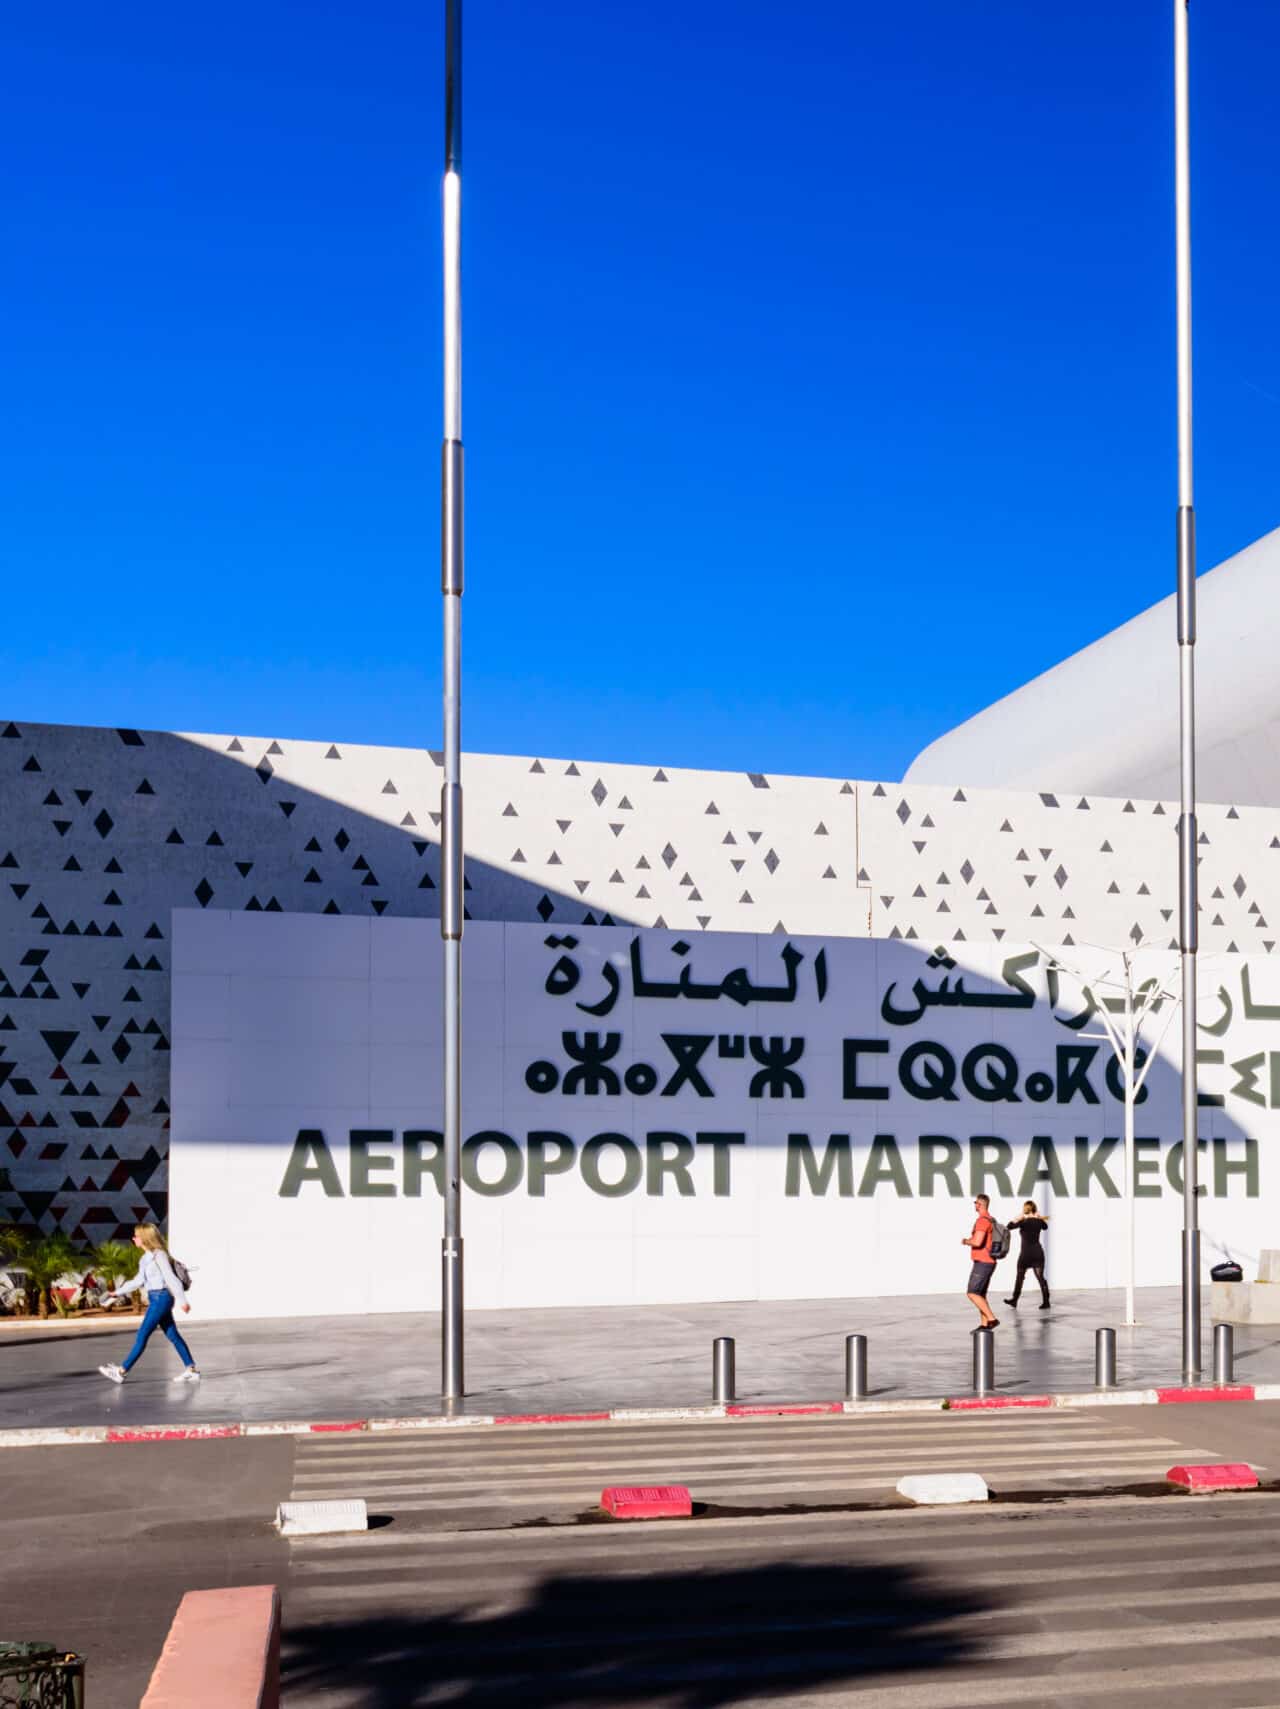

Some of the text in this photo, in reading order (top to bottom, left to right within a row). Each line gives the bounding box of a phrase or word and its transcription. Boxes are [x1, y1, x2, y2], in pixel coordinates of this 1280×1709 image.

[544, 934, 828, 1017] المنارة
[278, 1129, 745, 1198] AEROPORT
[784, 1133, 1259, 1199] MARRAKECH
